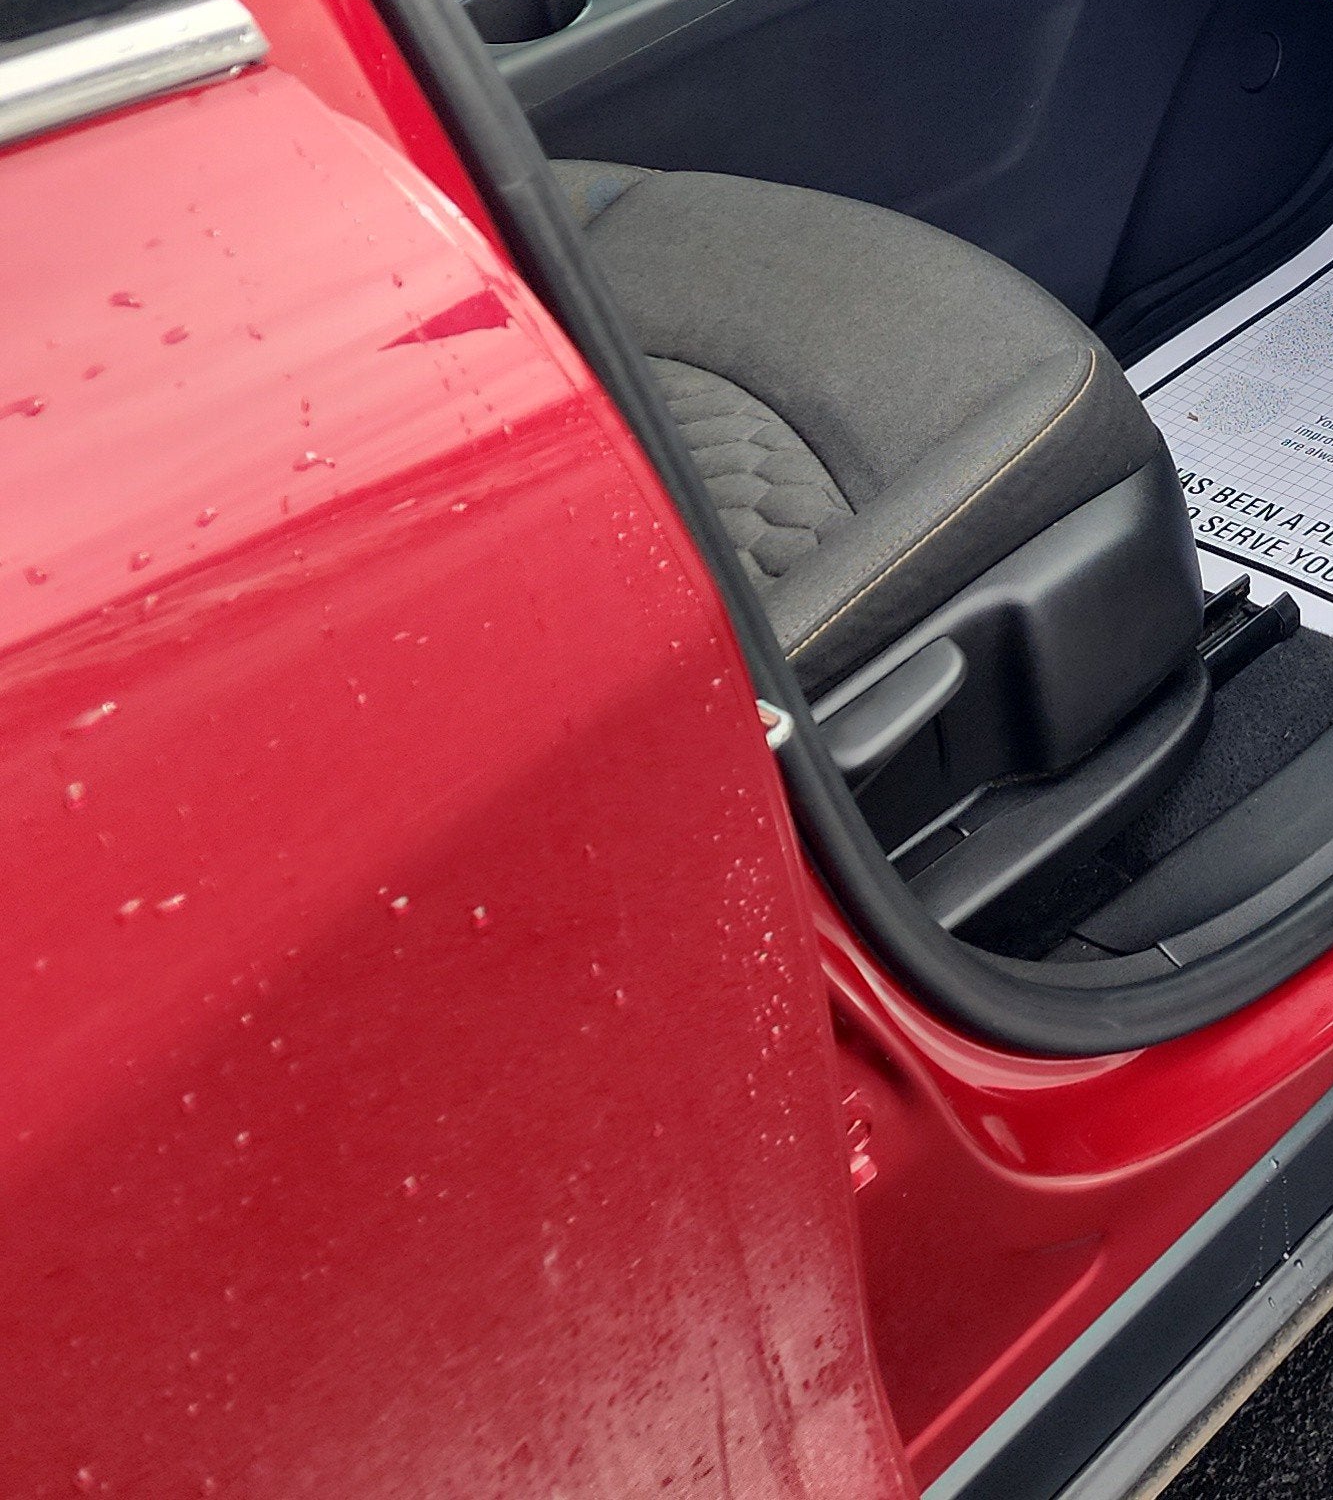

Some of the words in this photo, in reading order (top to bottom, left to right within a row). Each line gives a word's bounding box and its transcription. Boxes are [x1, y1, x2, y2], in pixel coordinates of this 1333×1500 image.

[1280, 438, 1305, 453] are
[1177, 467, 1214, 495] AS
[1209, 486, 1286, 522] BEEN
[1277, 513, 1305, 531] A
[1198, 515, 1290, 558] SERVE
